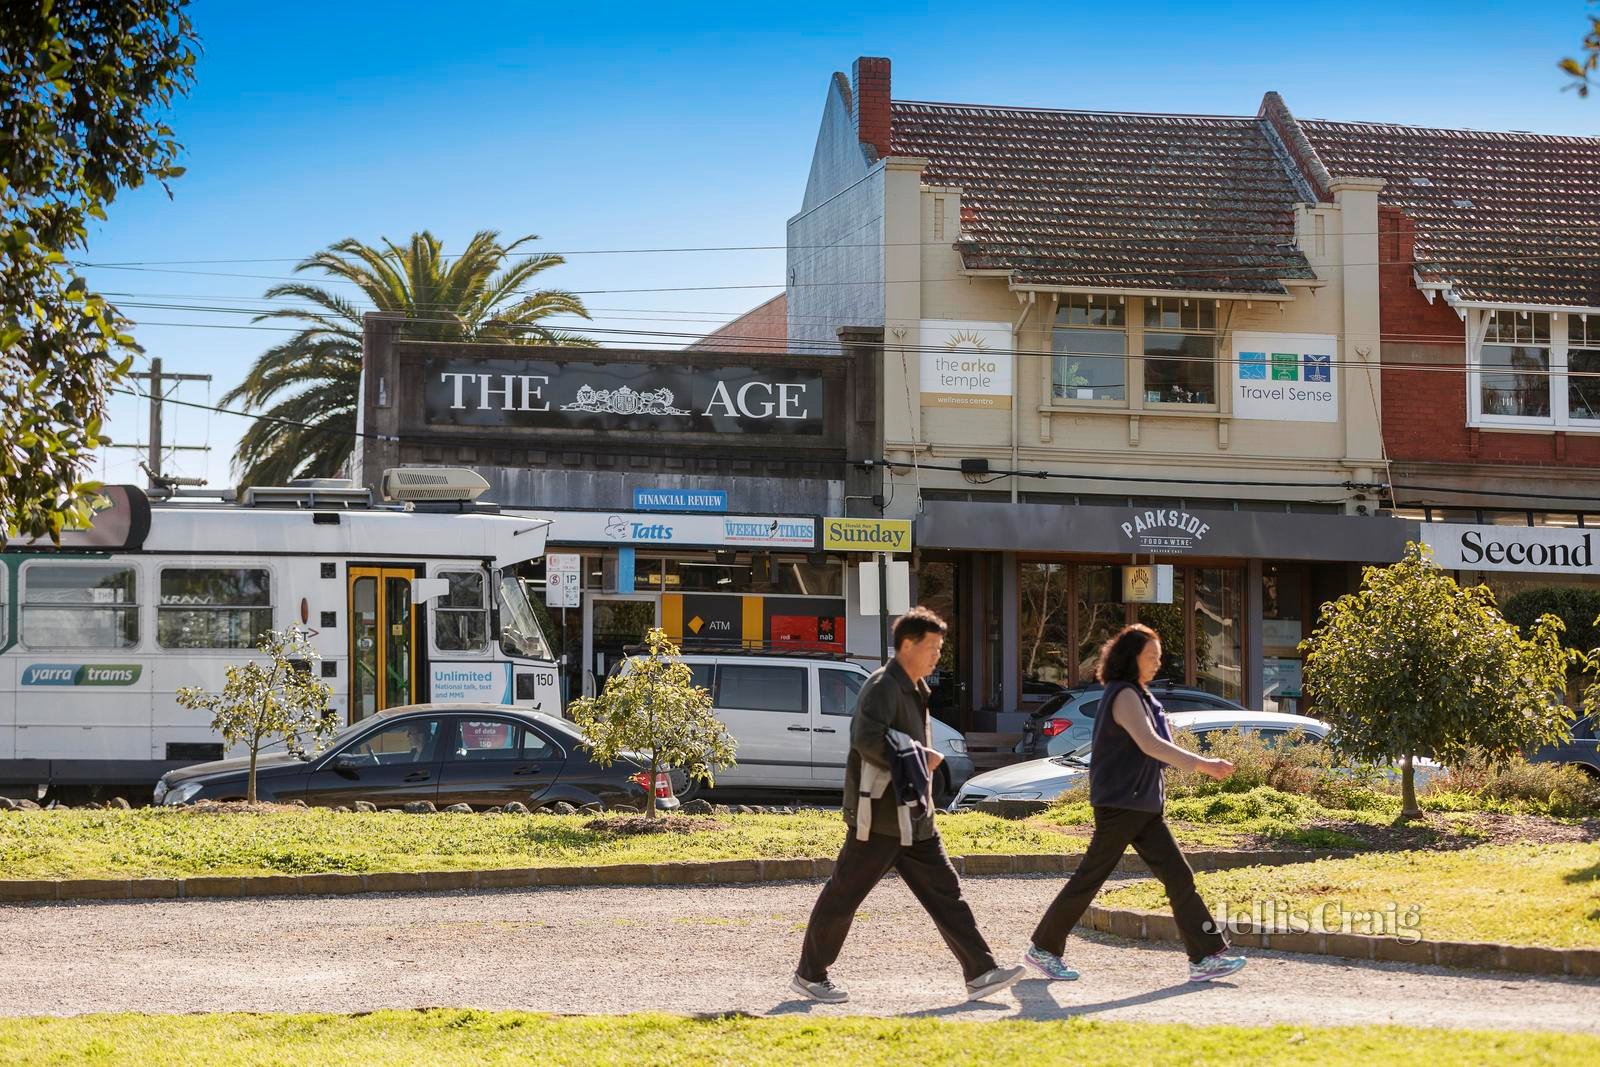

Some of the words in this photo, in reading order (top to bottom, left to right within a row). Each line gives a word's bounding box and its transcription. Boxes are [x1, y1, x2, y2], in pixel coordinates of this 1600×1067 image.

[936, 357, 958, 371] the
[961, 359, 996, 374] arka
[941, 374, 991, 390] temple
[441, 372, 550, 412] THE
[701, 381, 808, 419] AGE
[1240, 386, 1284, 400] Travel
[1289, 388, 1332, 402] Sense
[638, 494, 686, 506] FINANCIAL
[688, 496, 722, 506] REVIEW
[630, 522, 673, 540] Tatts
[725, 522, 772, 537] WEEKLY
[778, 524, 814, 538] TIMES
[1121, 509, 1210, 540] PARKSIDE
[830, 522, 905, 547] Sunday
[1461, 530, 1593, 567] Second
[566, 574, 577, 583] 1P
[709, 621, 731, 631] ATM
[819, 633, 834, 641] nab
[31, 668, 72, 683] yarra
[87, 667, 133, 681] trams
[435, 671, 492, 681] Unlimited
[536, 673, 554, 686] 150
[435, 683, 462, 691] National
[475, 727, 482, 735] of
[482, 727, 496, 735] data
